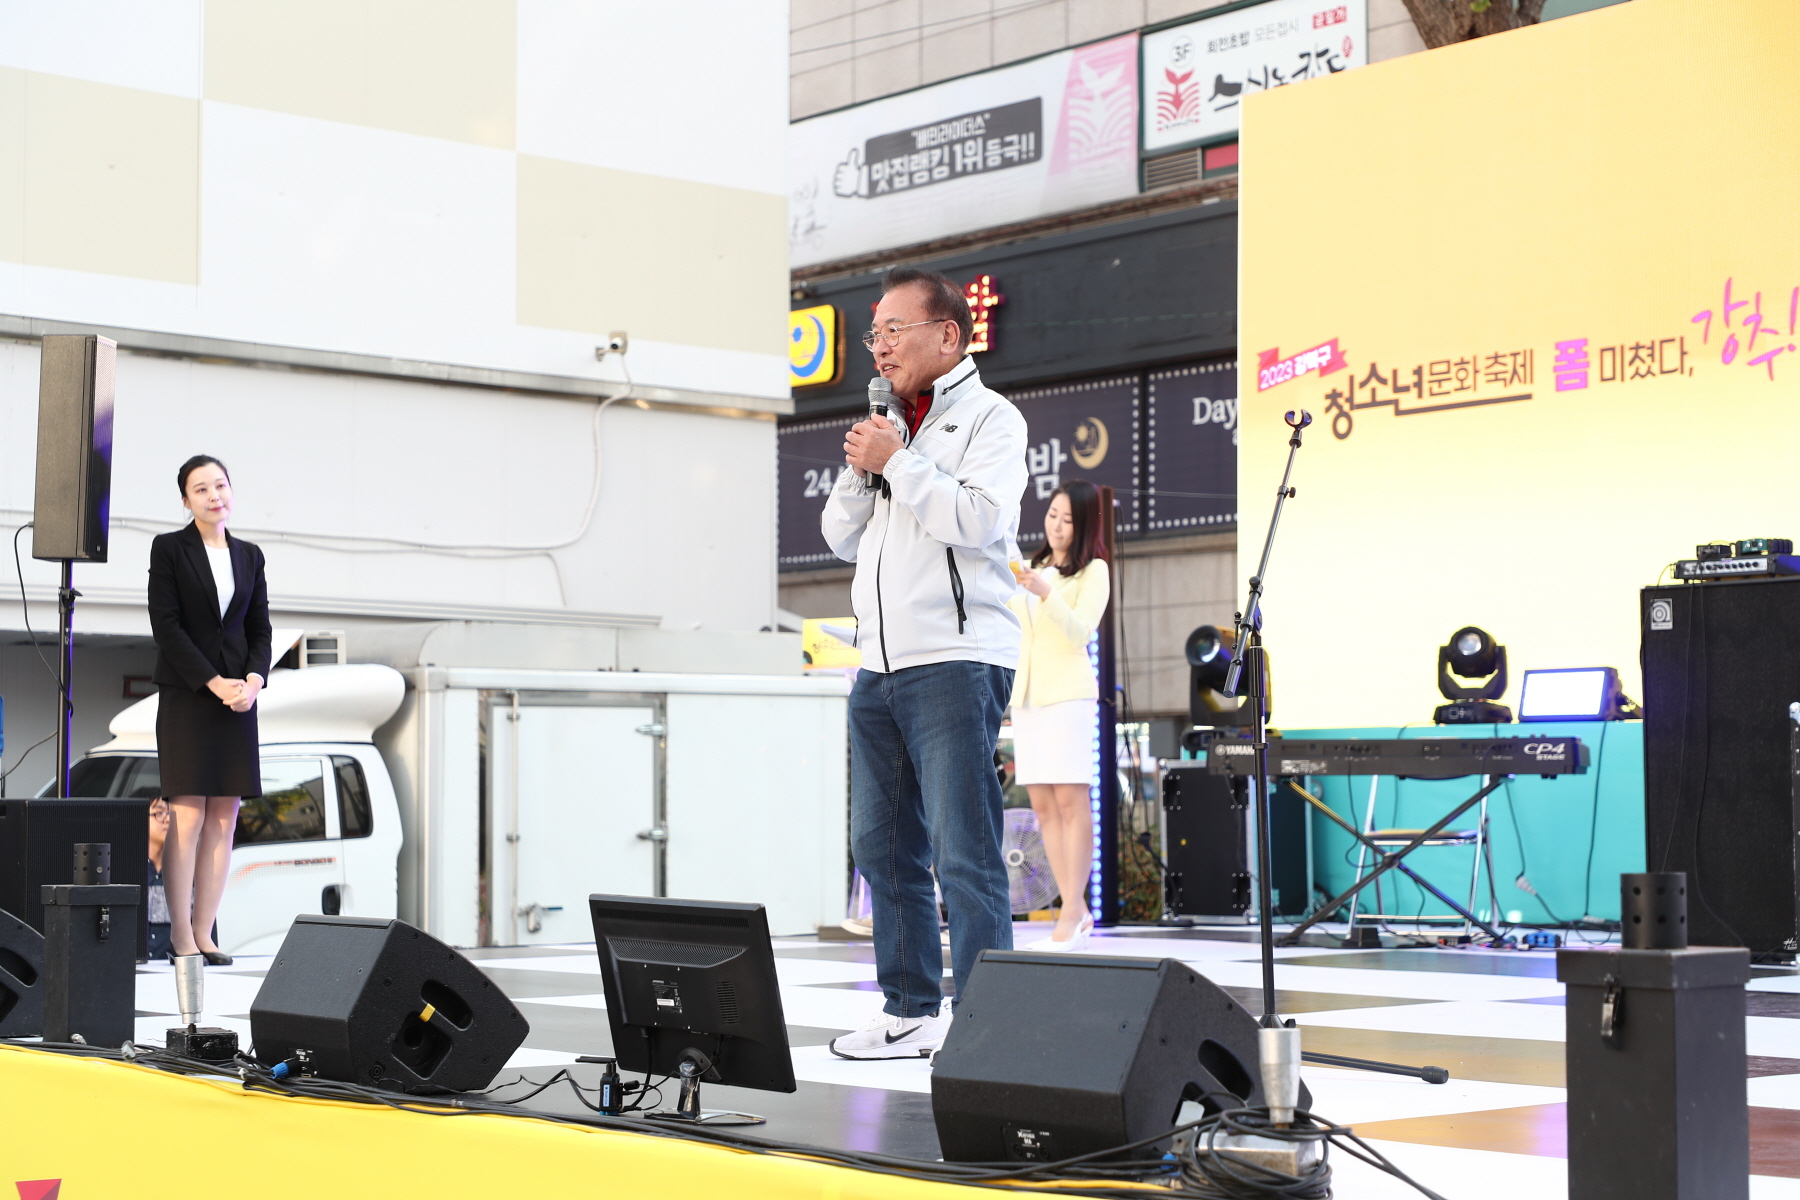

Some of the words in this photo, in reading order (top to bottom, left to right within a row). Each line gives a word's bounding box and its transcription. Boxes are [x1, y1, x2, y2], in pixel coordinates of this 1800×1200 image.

[1174, 43, 1192, 62] 3F
[871, 145, 949, 194] 맛집랭킹
[953, 137, 984, 173] 1위
[985, 132, 1035, 168] 등극!!
[1553, 338, 1590, 392] 폼
[1600, 336, 1693, 382] 미쳤다,
[1691, 277, 1800, 382] 강추!
[1260, 360, 1294, 390] 2023
[1192, 397, 1237, 430] Day
[1027, 438, 1067, 500] 밤
[1225, 744, 1255, 755] YAMAH
[1523, 742, 1566, 755] CP4
